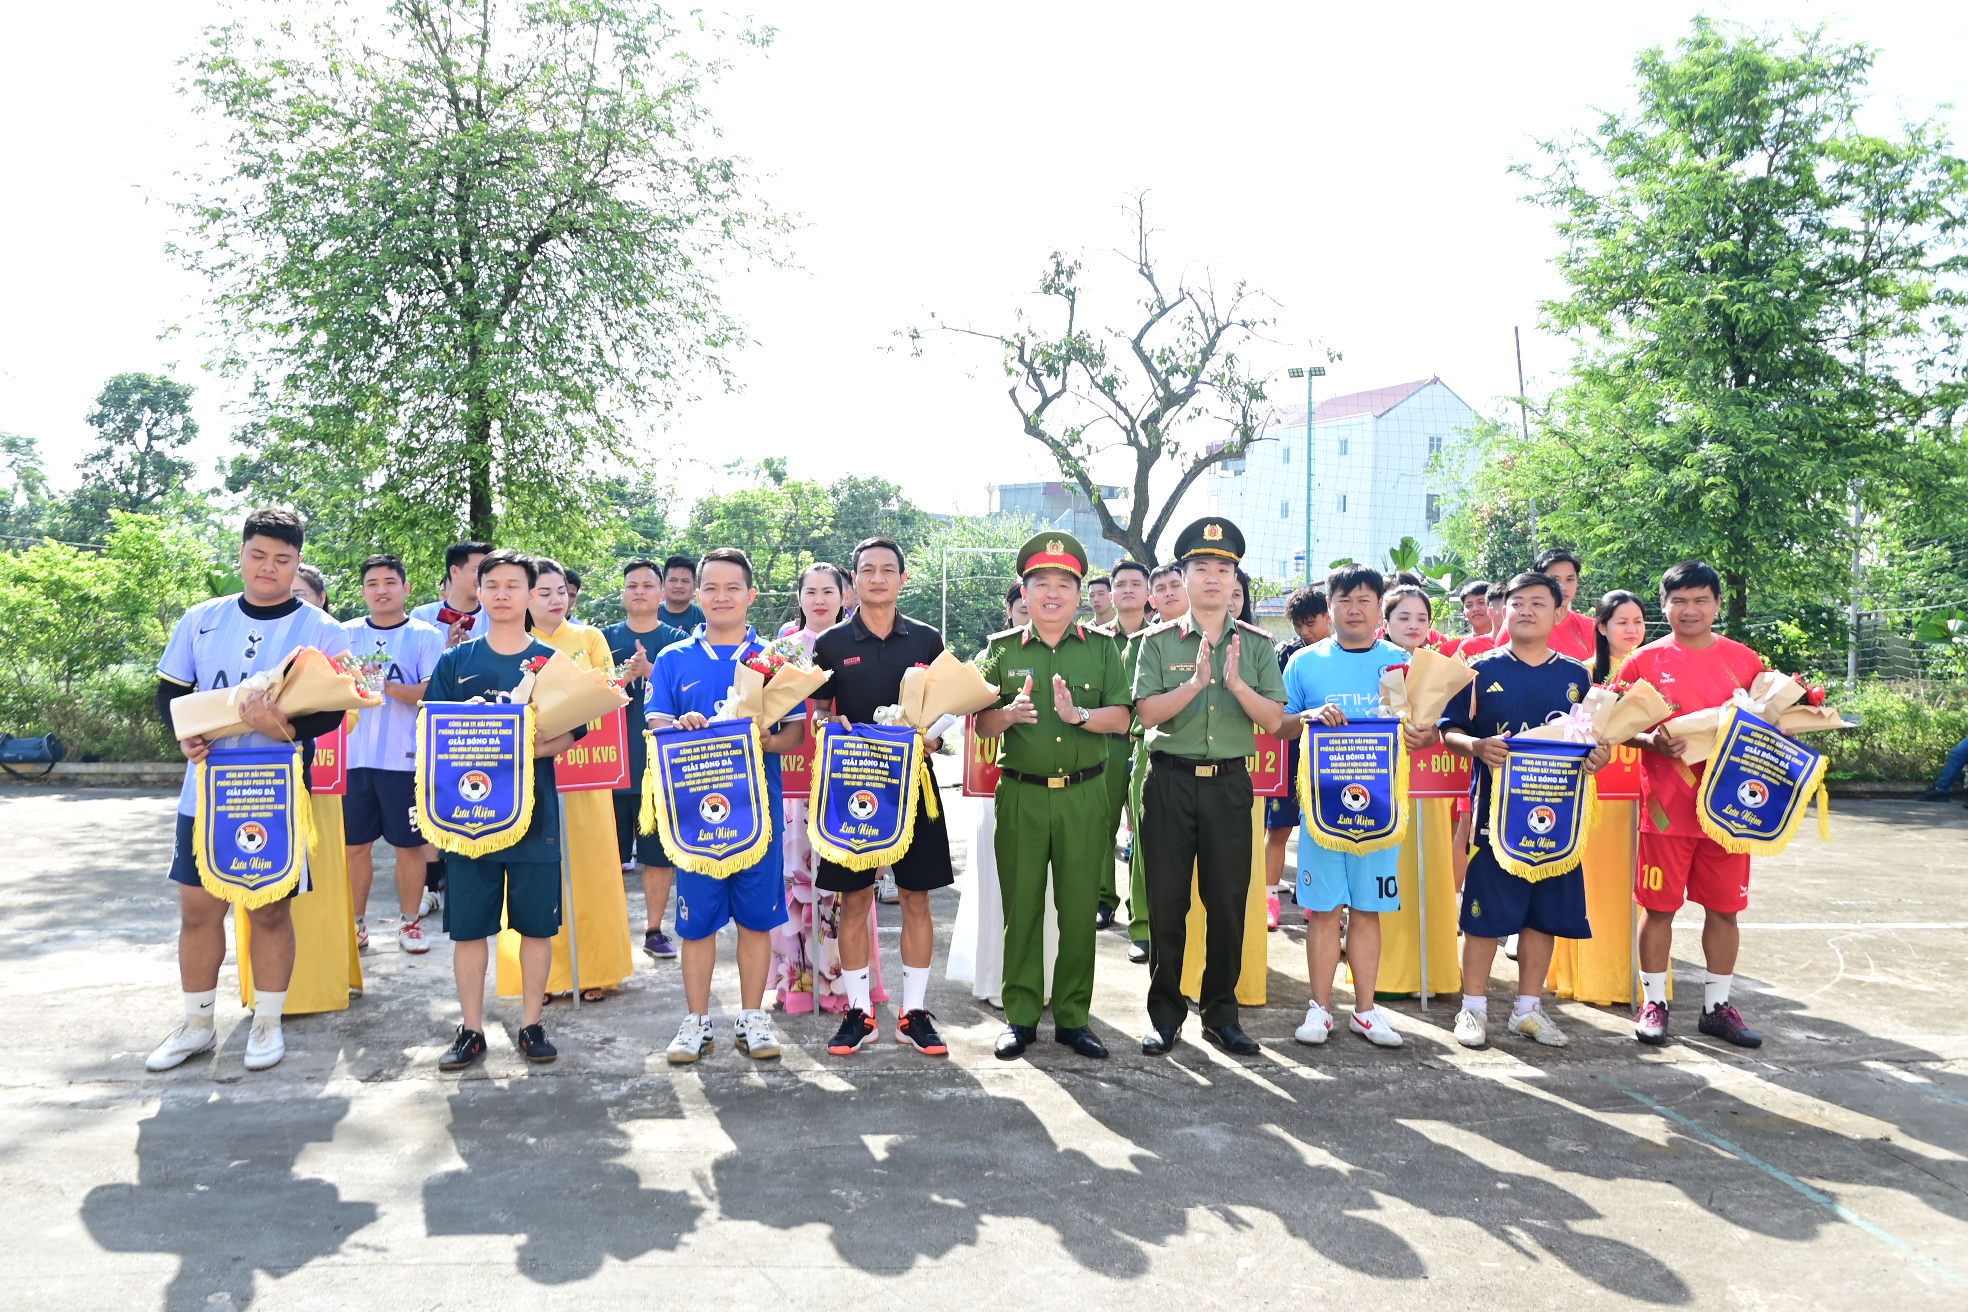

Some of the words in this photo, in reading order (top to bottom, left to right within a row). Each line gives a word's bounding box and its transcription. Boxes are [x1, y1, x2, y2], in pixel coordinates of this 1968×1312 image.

[1325, 693, 1380, 706] ETIHA
[448, 737, 465, 745] GIẢI
[466, 737, 487, 745] BÓNG
[489, 736, 500, 744] ĐÁ
[567, 744, 589, 768] ĐỘI
[593, 746, 617, 763] KV6
[781, 755, 805, 772] KV2
[842, 757, 858, 765] GIẢI
[859, 758, 878, 767] BÓNG
[879, 761, 889, 769] ĐÁ
[1265, 751, 1276, 772] 2
[1329, 753, 1345, 761] GIẢI
[1431, 750, 1455, 776] ĐỘI
[1460, 756, 1468, 772] 4
[682, 762, 698, 772] GIẢI
[700, 760, 720, 769] BÓNG
[722, 757, 732, 766] ĐÁ
[1521, 774, 1537, 782] GIẢI
[1538, 775, 1557, 783] BÓNG
[226, 787, 241, 796] GIẢI
[242, 788, 263, 796] BÓNG
[264, 787, 275, 795] ĐÁ
[1643, 864, 1663, 890] 10
[1376, 876, 1398, 898] 10
